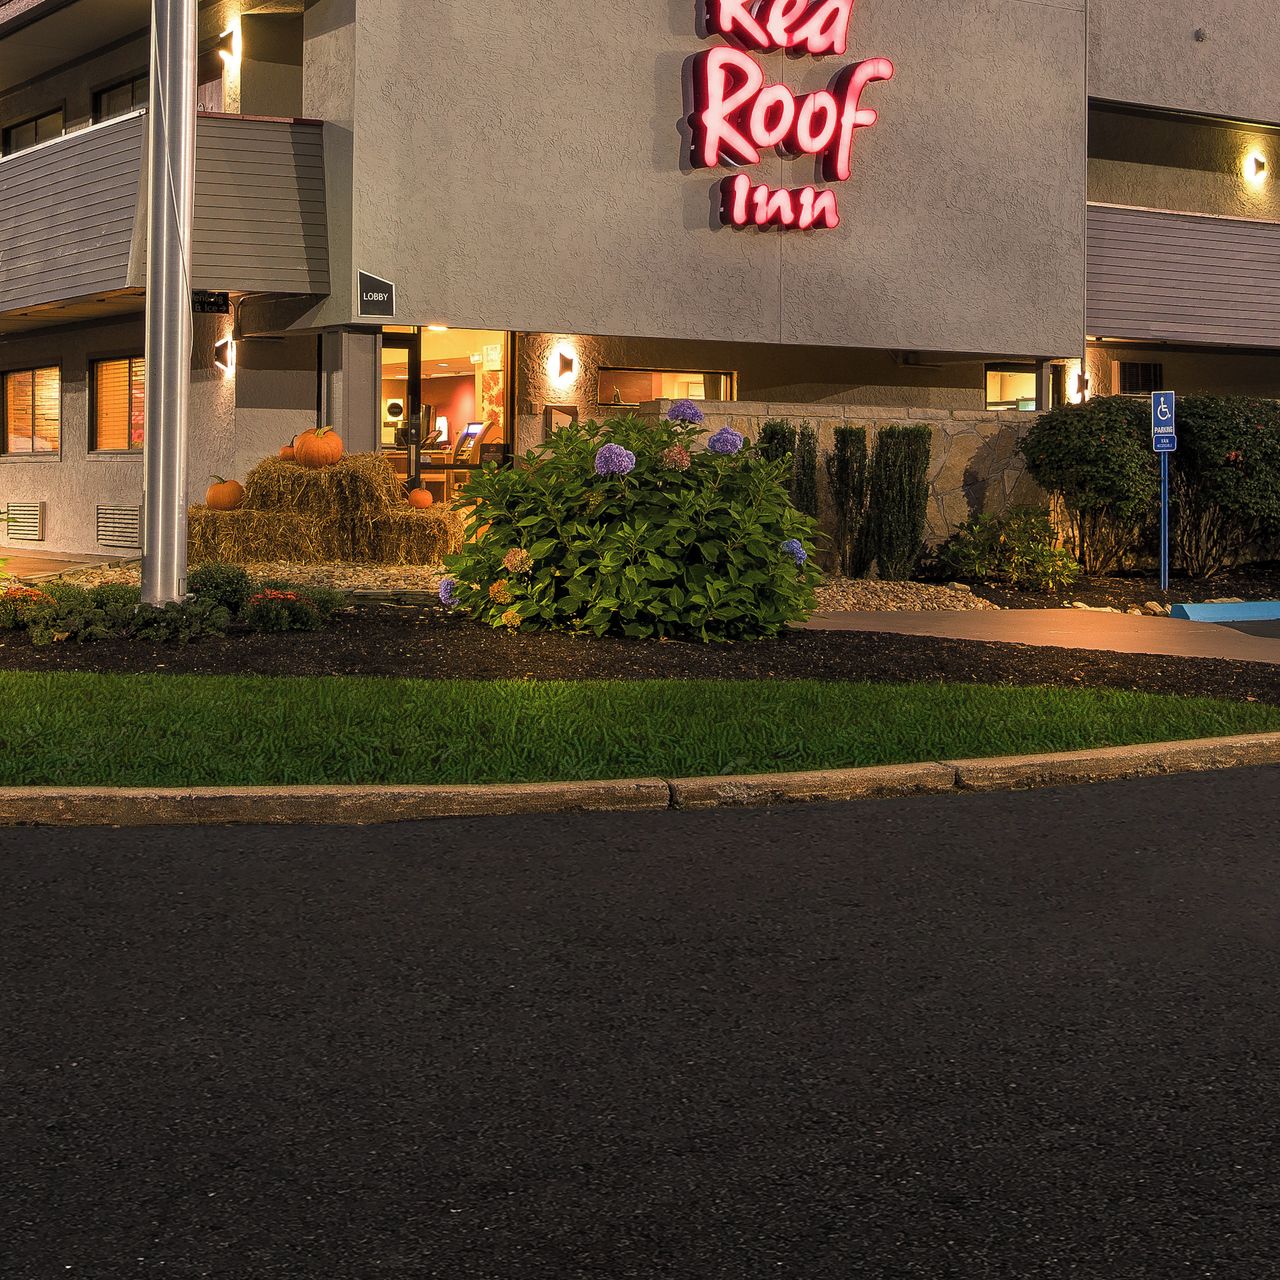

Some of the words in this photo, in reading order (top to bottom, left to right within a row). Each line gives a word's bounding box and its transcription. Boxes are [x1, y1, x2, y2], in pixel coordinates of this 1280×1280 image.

[701, 46, 894, 181] Roof
[731, 173, 841, 229] Inn
[363, 292, 389, 301] LOBBY
